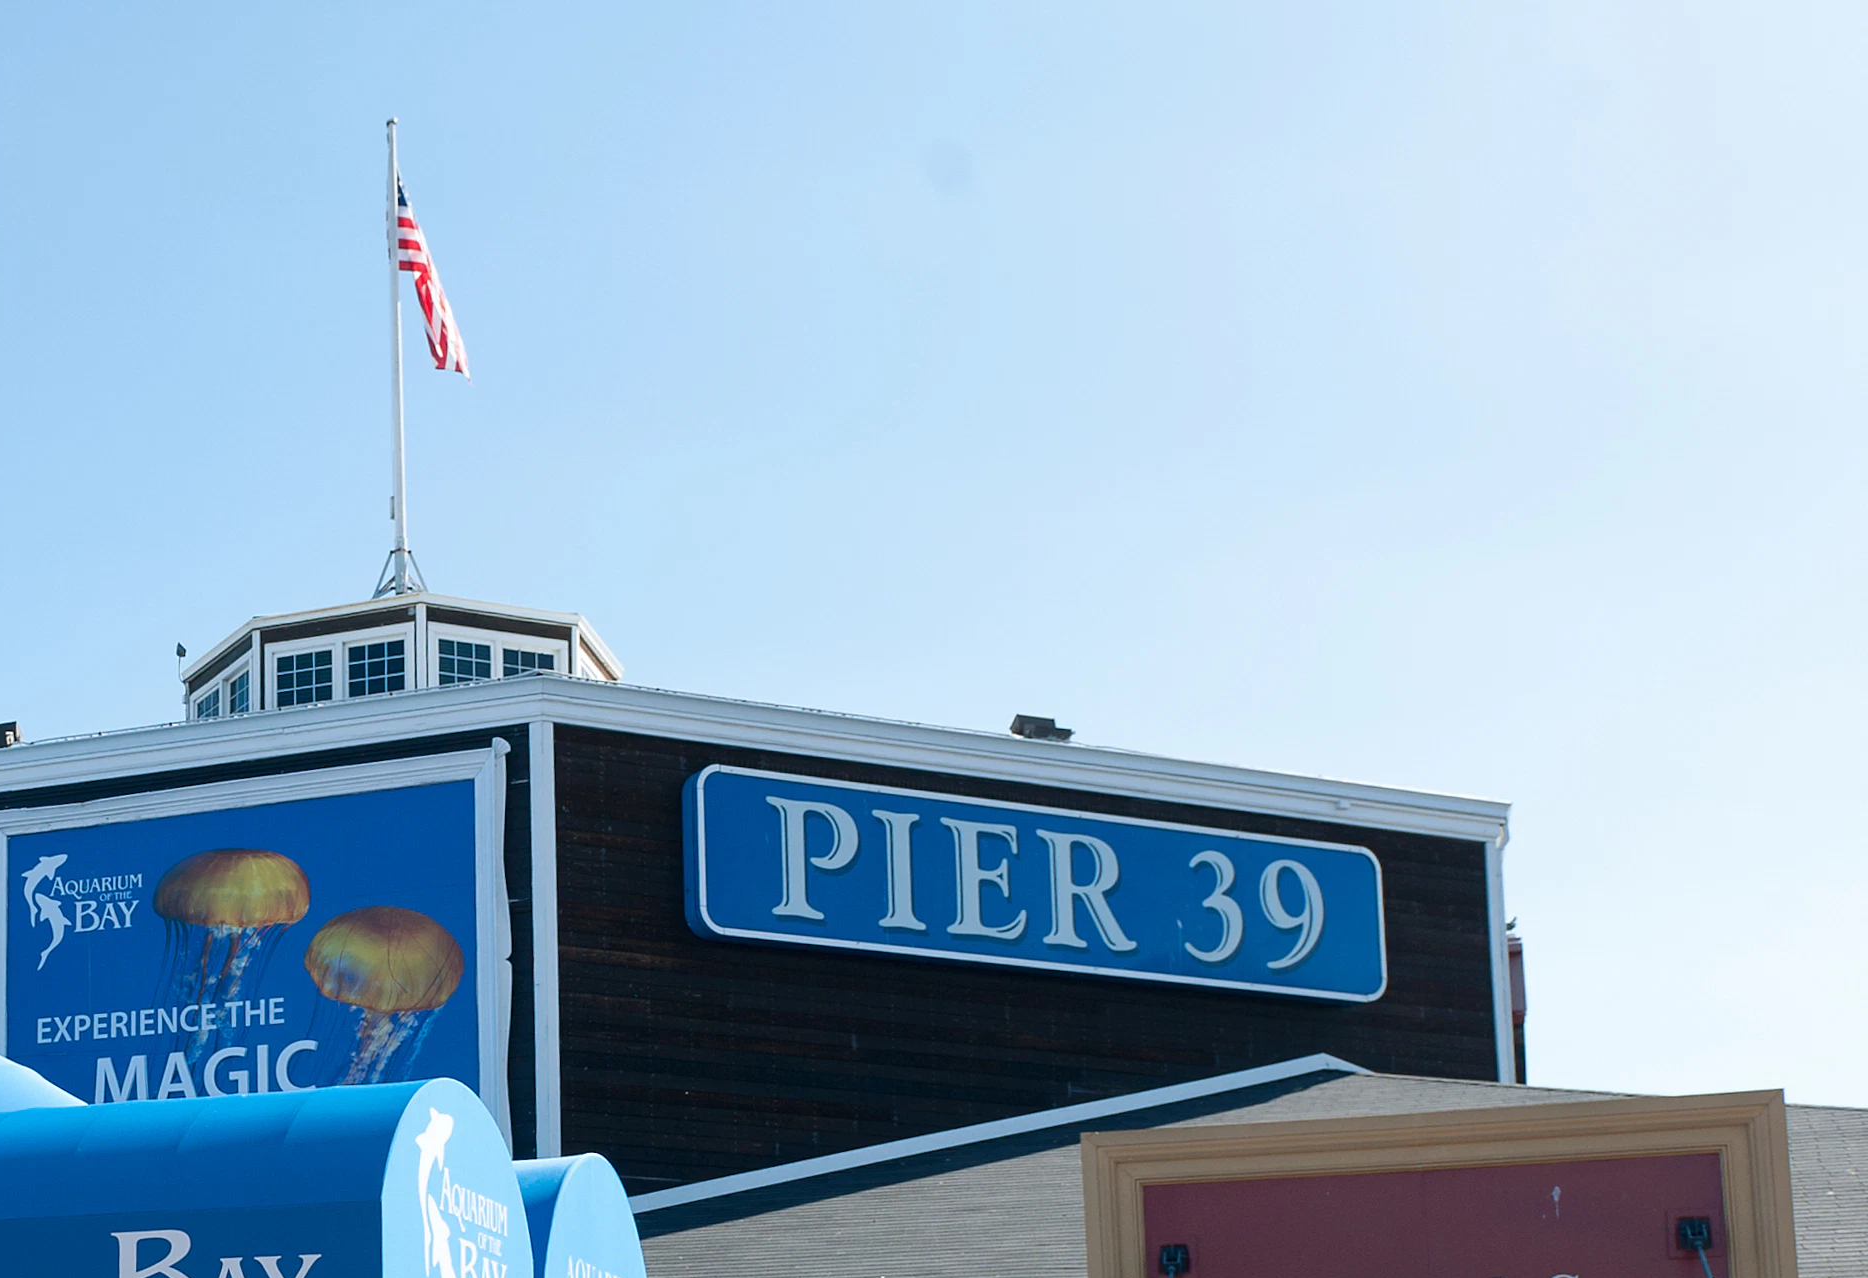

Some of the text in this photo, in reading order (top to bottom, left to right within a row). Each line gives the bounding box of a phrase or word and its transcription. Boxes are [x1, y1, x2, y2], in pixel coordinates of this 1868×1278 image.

[49, 873, 142, 900] AQUARIUM
[99, 890, 132, 902] OF THE
[766, 795, 1325, 970] PIER 39
[74, 900, 139, 932] BAY
[36, 997, 286, 1045] EXPERIENCE THE
[94, 1039, 320, 1103] MAGIC
[439, 1166, 509, 1237] AQUARIUM
[477, 1232, 502, 1257] OF THE
